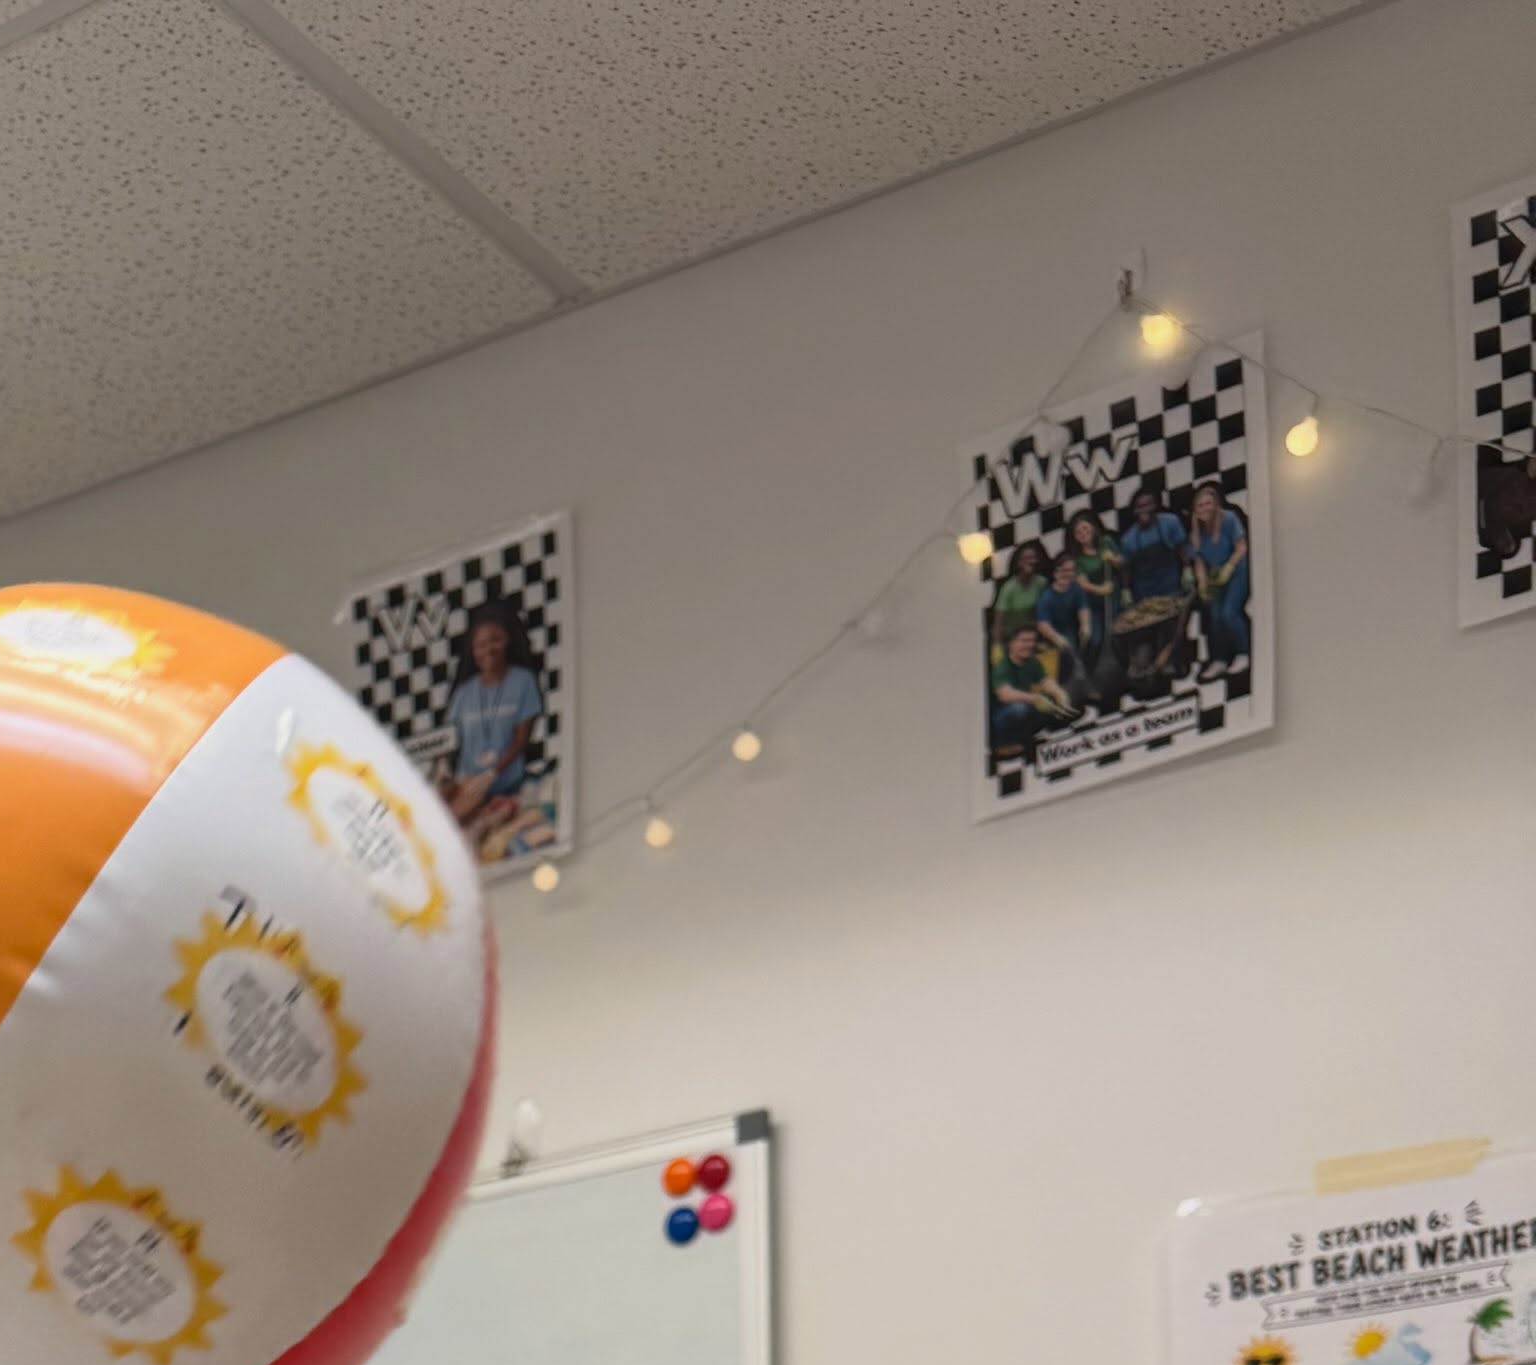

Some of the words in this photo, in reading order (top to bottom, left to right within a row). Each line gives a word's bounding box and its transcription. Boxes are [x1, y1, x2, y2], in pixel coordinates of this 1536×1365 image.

[992, 432, 1140, 518] Ww
[1039, 736, 1095, 764] Work
[1098, 730, 1122, 746] as
[1125, 723, 1140, 738] a
[1143, 706, 1193, 732] team
[1318, 1215, 1417, 1250] STATION
[1228, 1260, 1300, 1301] BEST
[1311, 1244, 1405, 1286] BEACH
